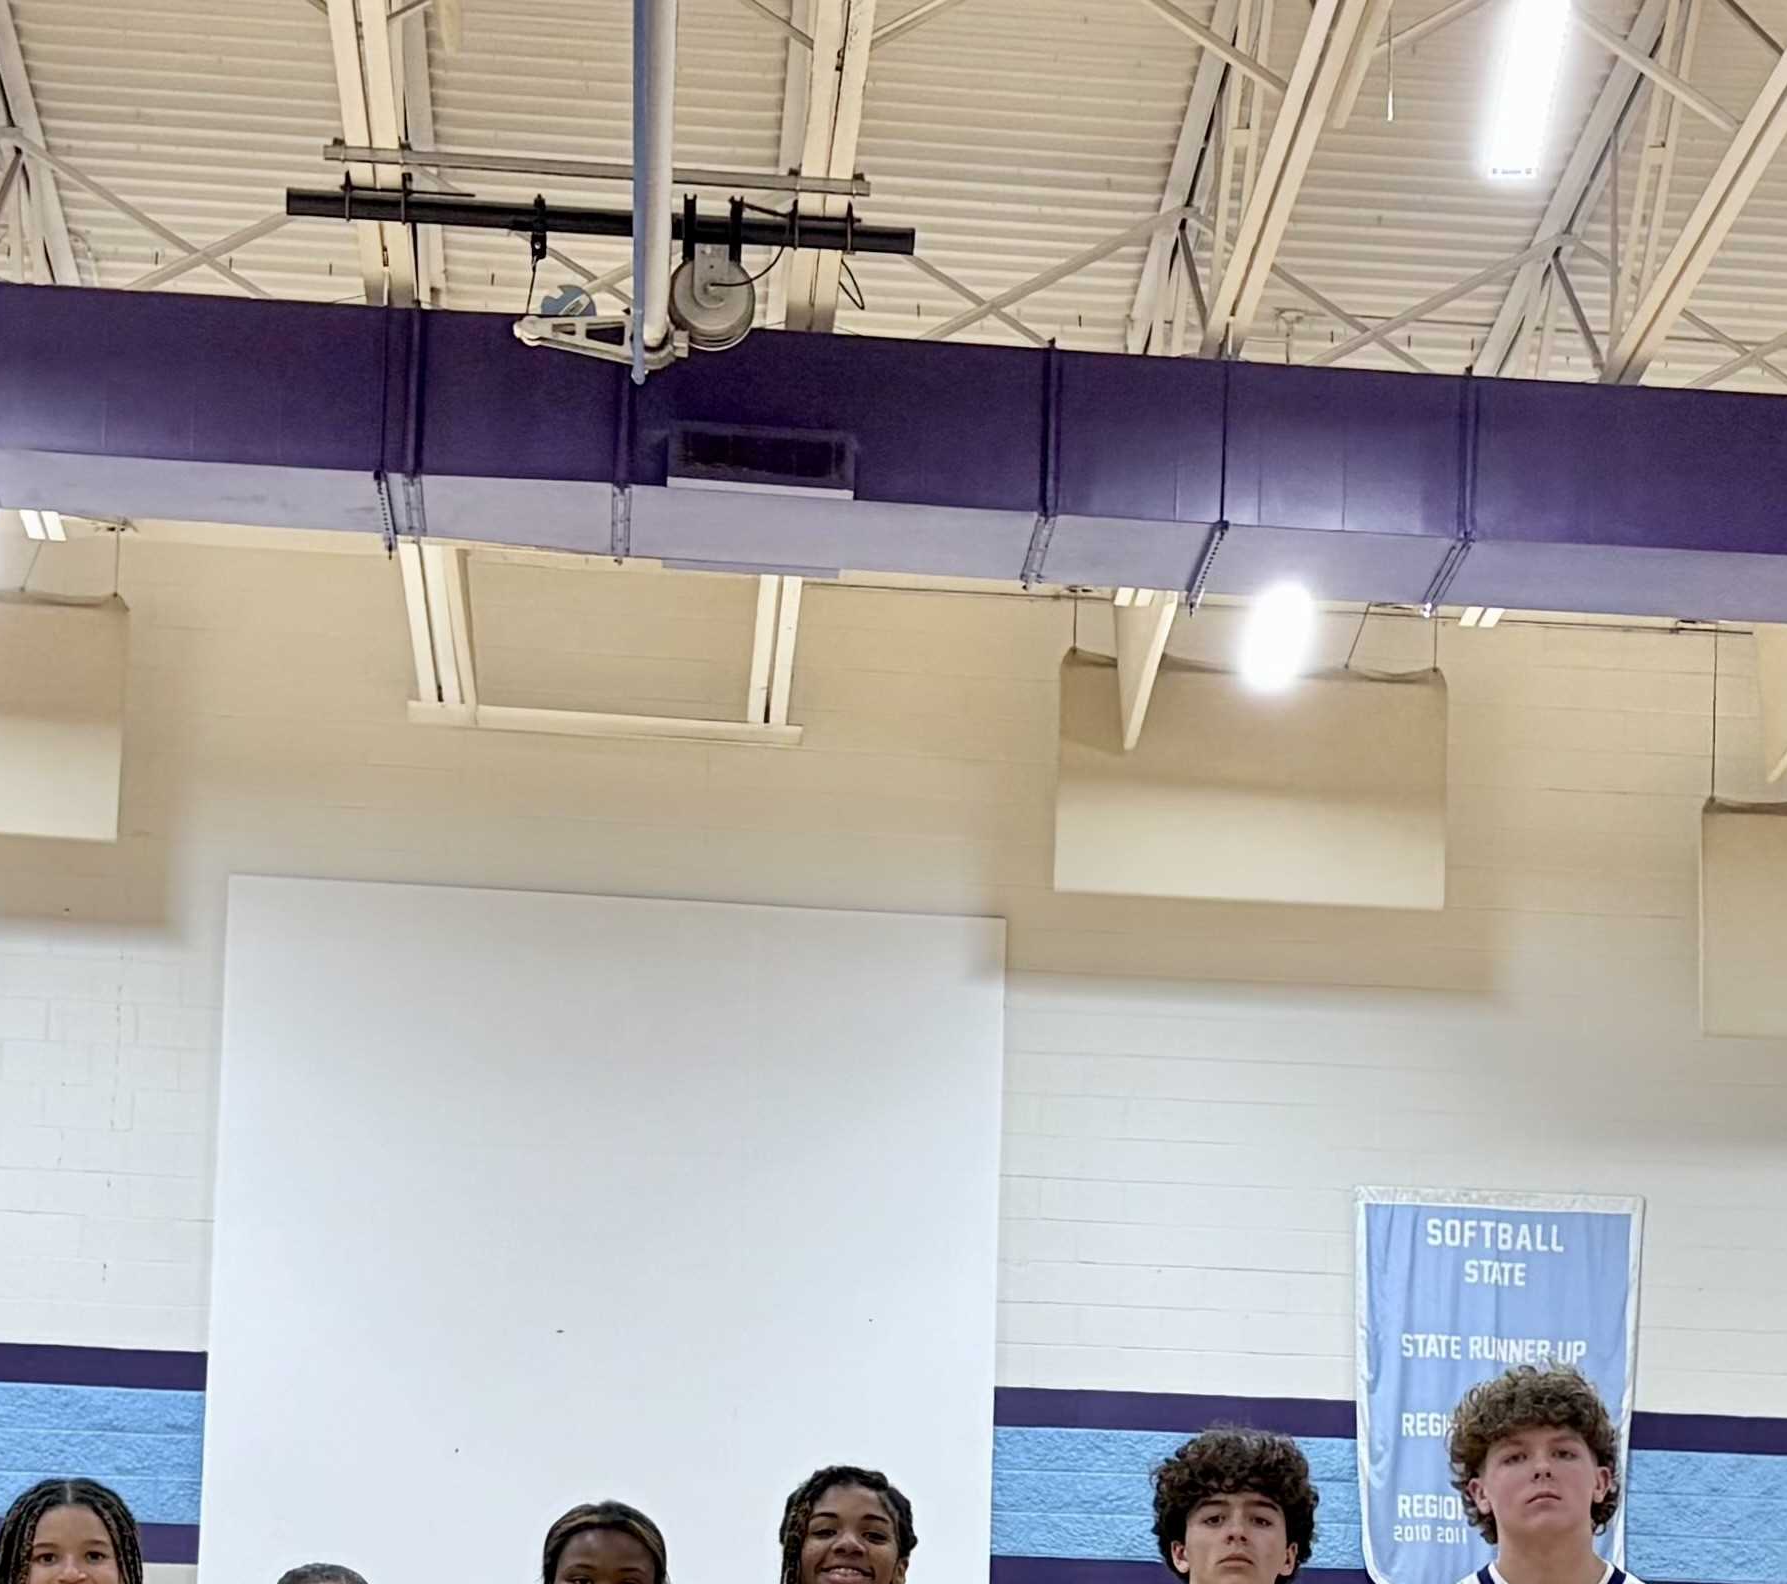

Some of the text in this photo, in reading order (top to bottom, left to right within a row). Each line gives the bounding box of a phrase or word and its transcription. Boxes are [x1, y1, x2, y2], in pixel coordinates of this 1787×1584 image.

[1426, 1218, 1564, 1252] SOFTBALL
[1464, 1259, 1526, 1286] STATE
[1401, 1333, 1587, 1364] STATE RUNNER-UP
[1393, 1525, 1468, 1544] 2010 2011
